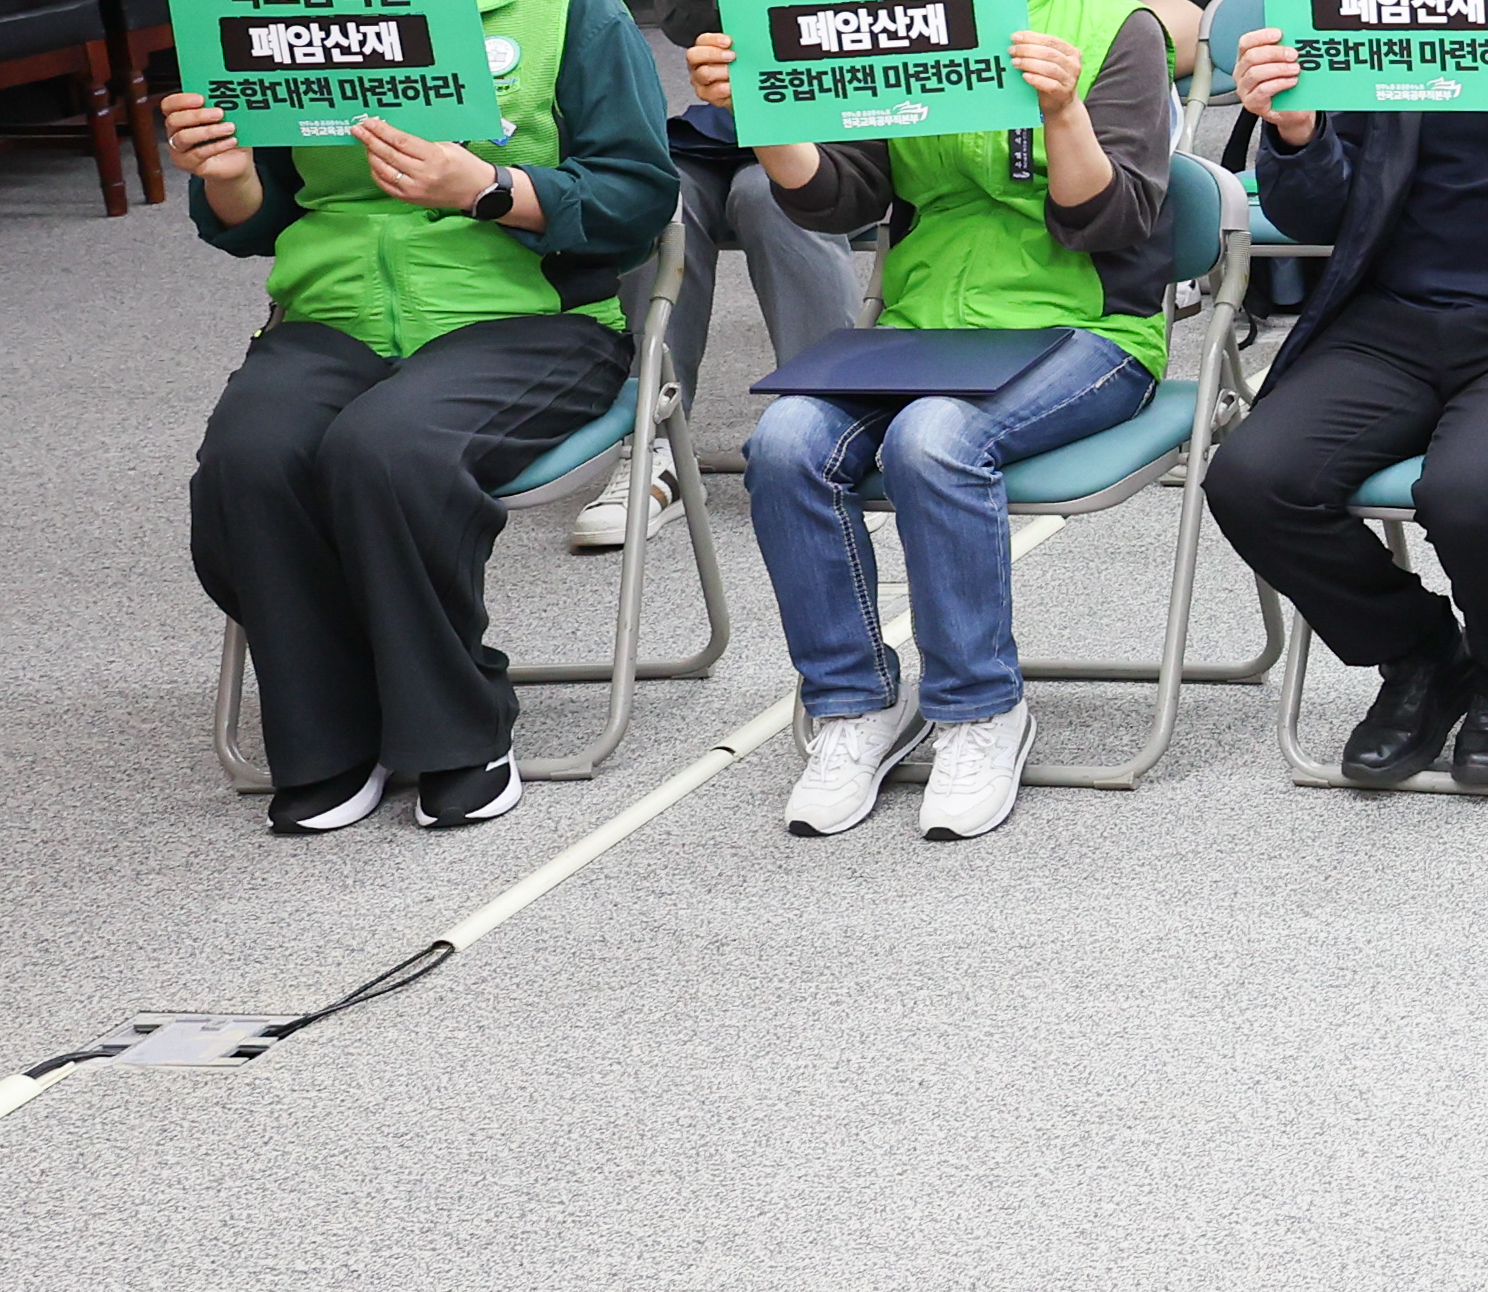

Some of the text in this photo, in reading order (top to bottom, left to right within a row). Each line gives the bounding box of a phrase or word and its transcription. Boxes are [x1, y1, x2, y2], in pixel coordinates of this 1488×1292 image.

[248, 21, 402, 64] 폐암산재
[797, 2, 948, 52] 폐암산재
[1292, 37, 1412, 71] 종합대책
[207, 73, 463, 111] 종합대책 마련하라
[756, 55, 1006, 103] 종합대책 마련하라
